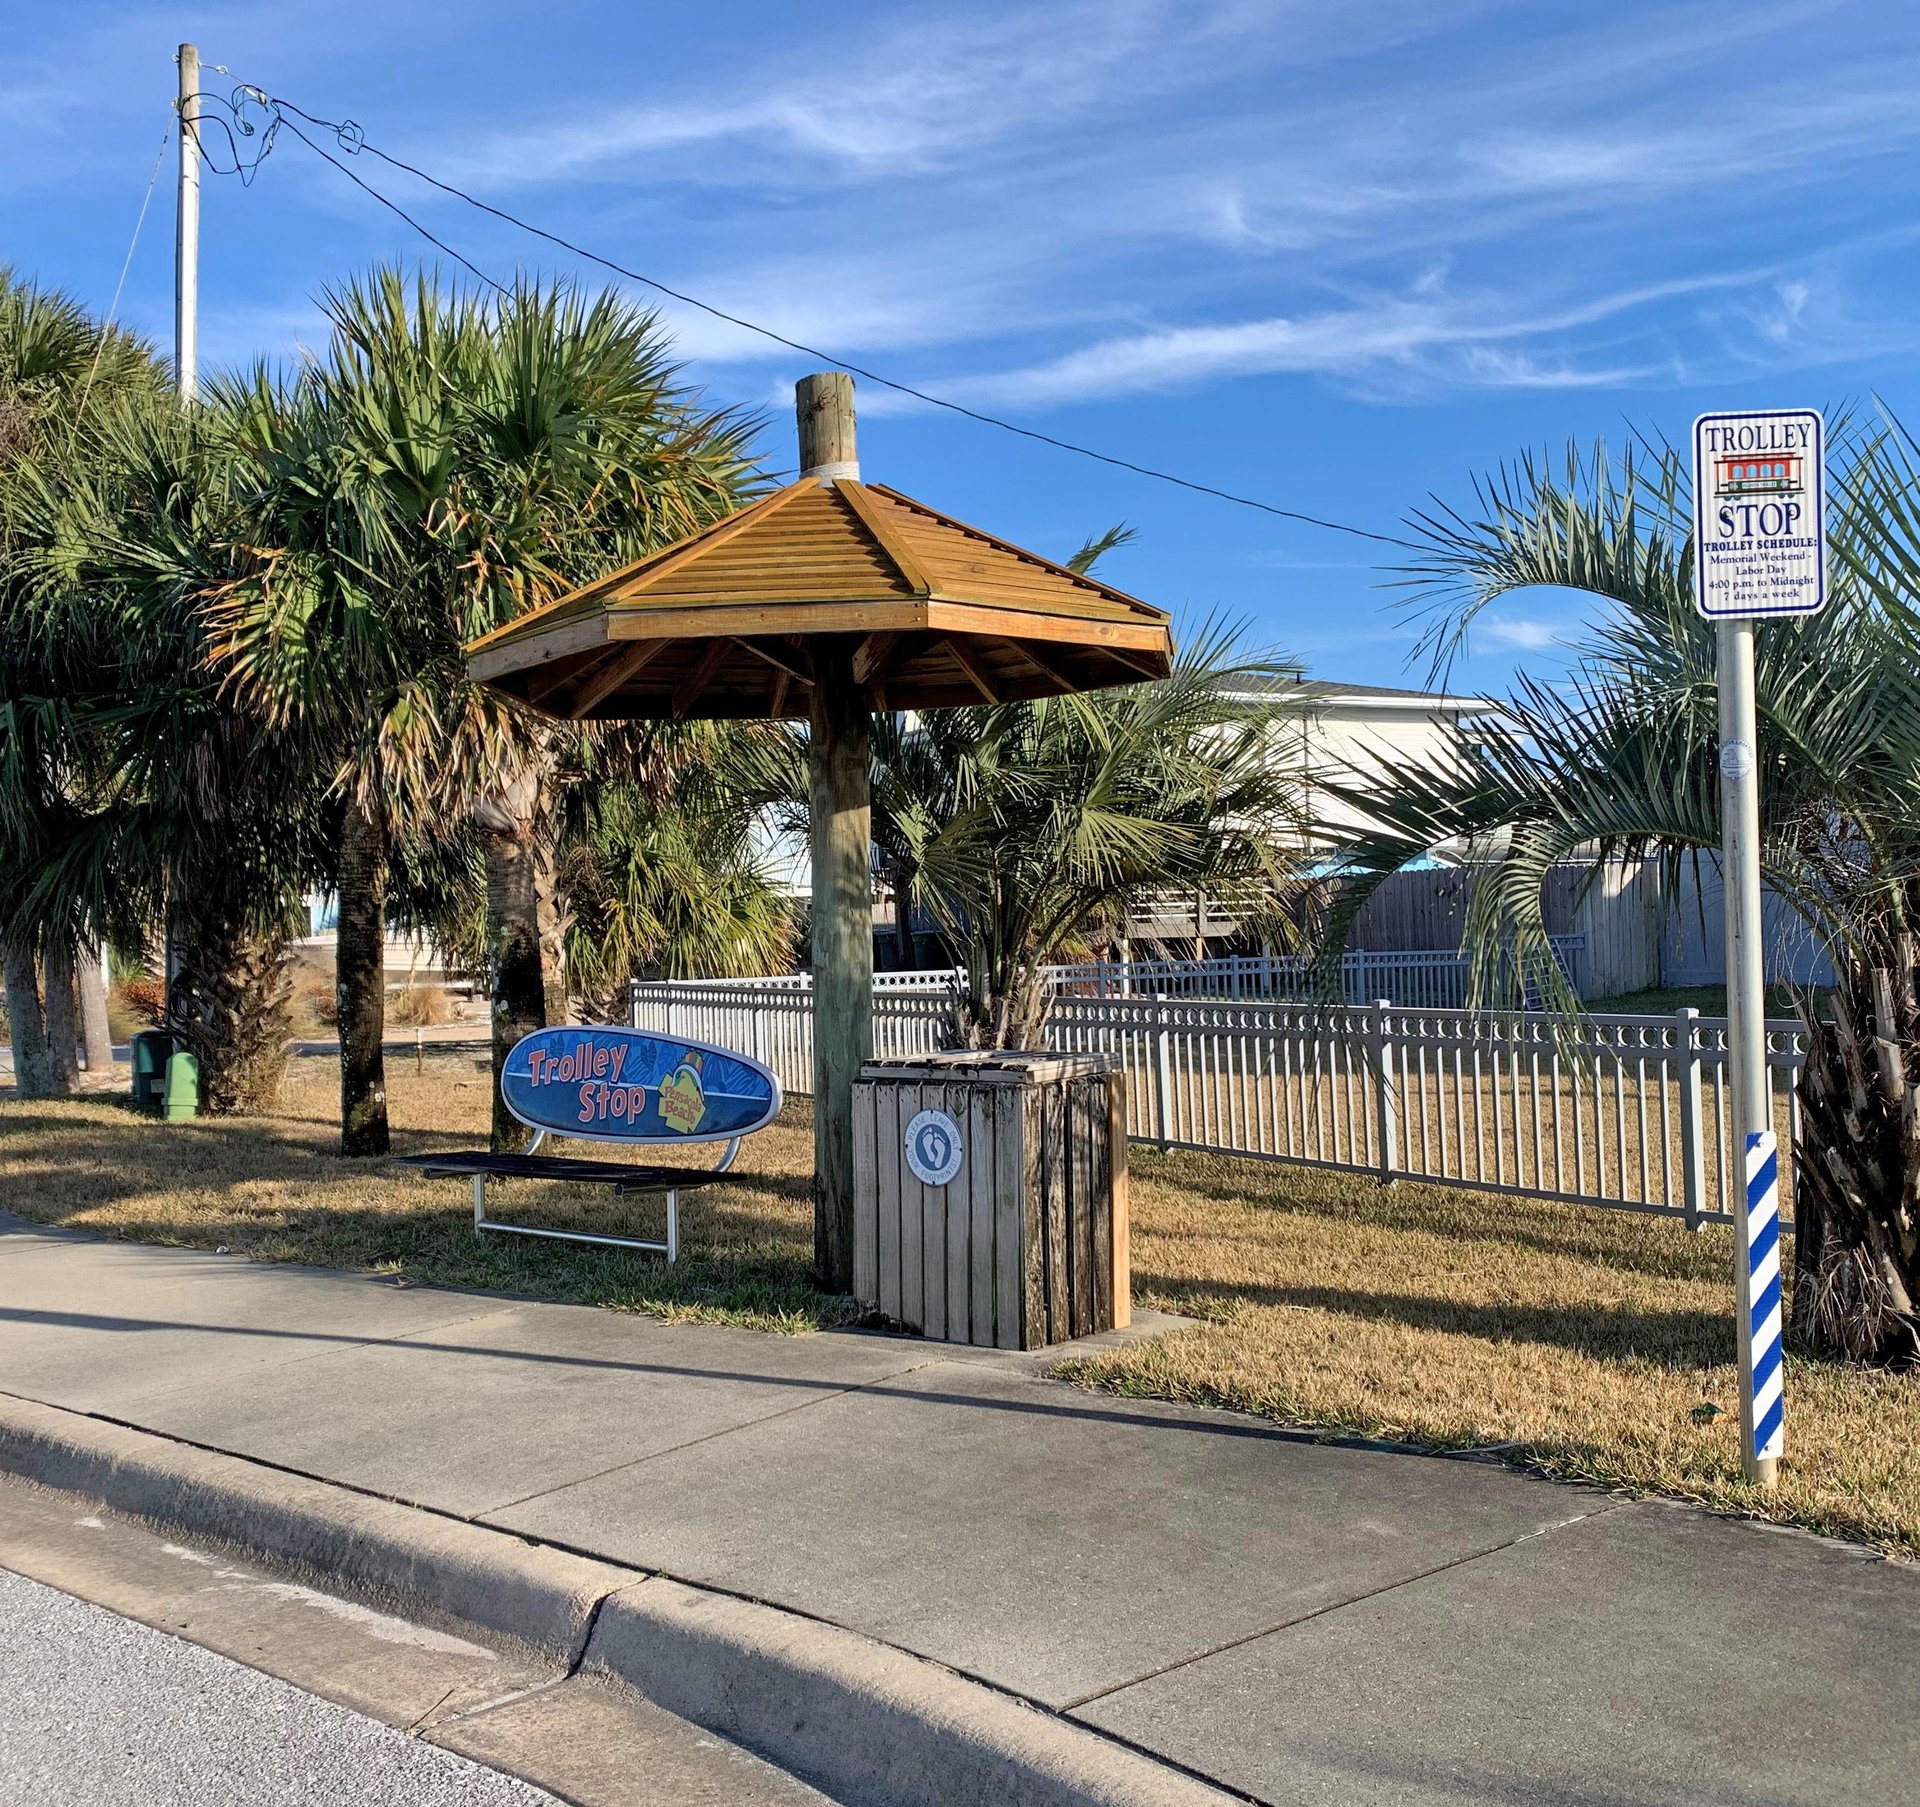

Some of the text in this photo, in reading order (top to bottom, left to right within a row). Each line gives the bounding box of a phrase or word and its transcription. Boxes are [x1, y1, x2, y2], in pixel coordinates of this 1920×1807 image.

[1705, 423, 1810, 452] TROLLEY
[1718, 502, 1801, 538] STOP
[1704, 538, 1818, 552] TROLLEY SCHEDULE:
[1710, 553, 1757, 564] Memorial
[1760, 551, 1805, 562] Weekend
[1736, 564, 1786, 576] Labor Day
[1708, 576, 1814, 591] 4:00 p.m. to Midnight
[1724, 589, 1800, 602] 7 days a week
[528, 1041, 628, 1087] Trolley
[577, 1081, 646, 1125] Stop
[664, 1086, 702, 1113] Pensacola
[664, 1100, 696, 1125] Beach
[908, 1113, 959, 1151] PLEASE LEAVE ONLY
[908, 1150, 920, 1169] YOUR
